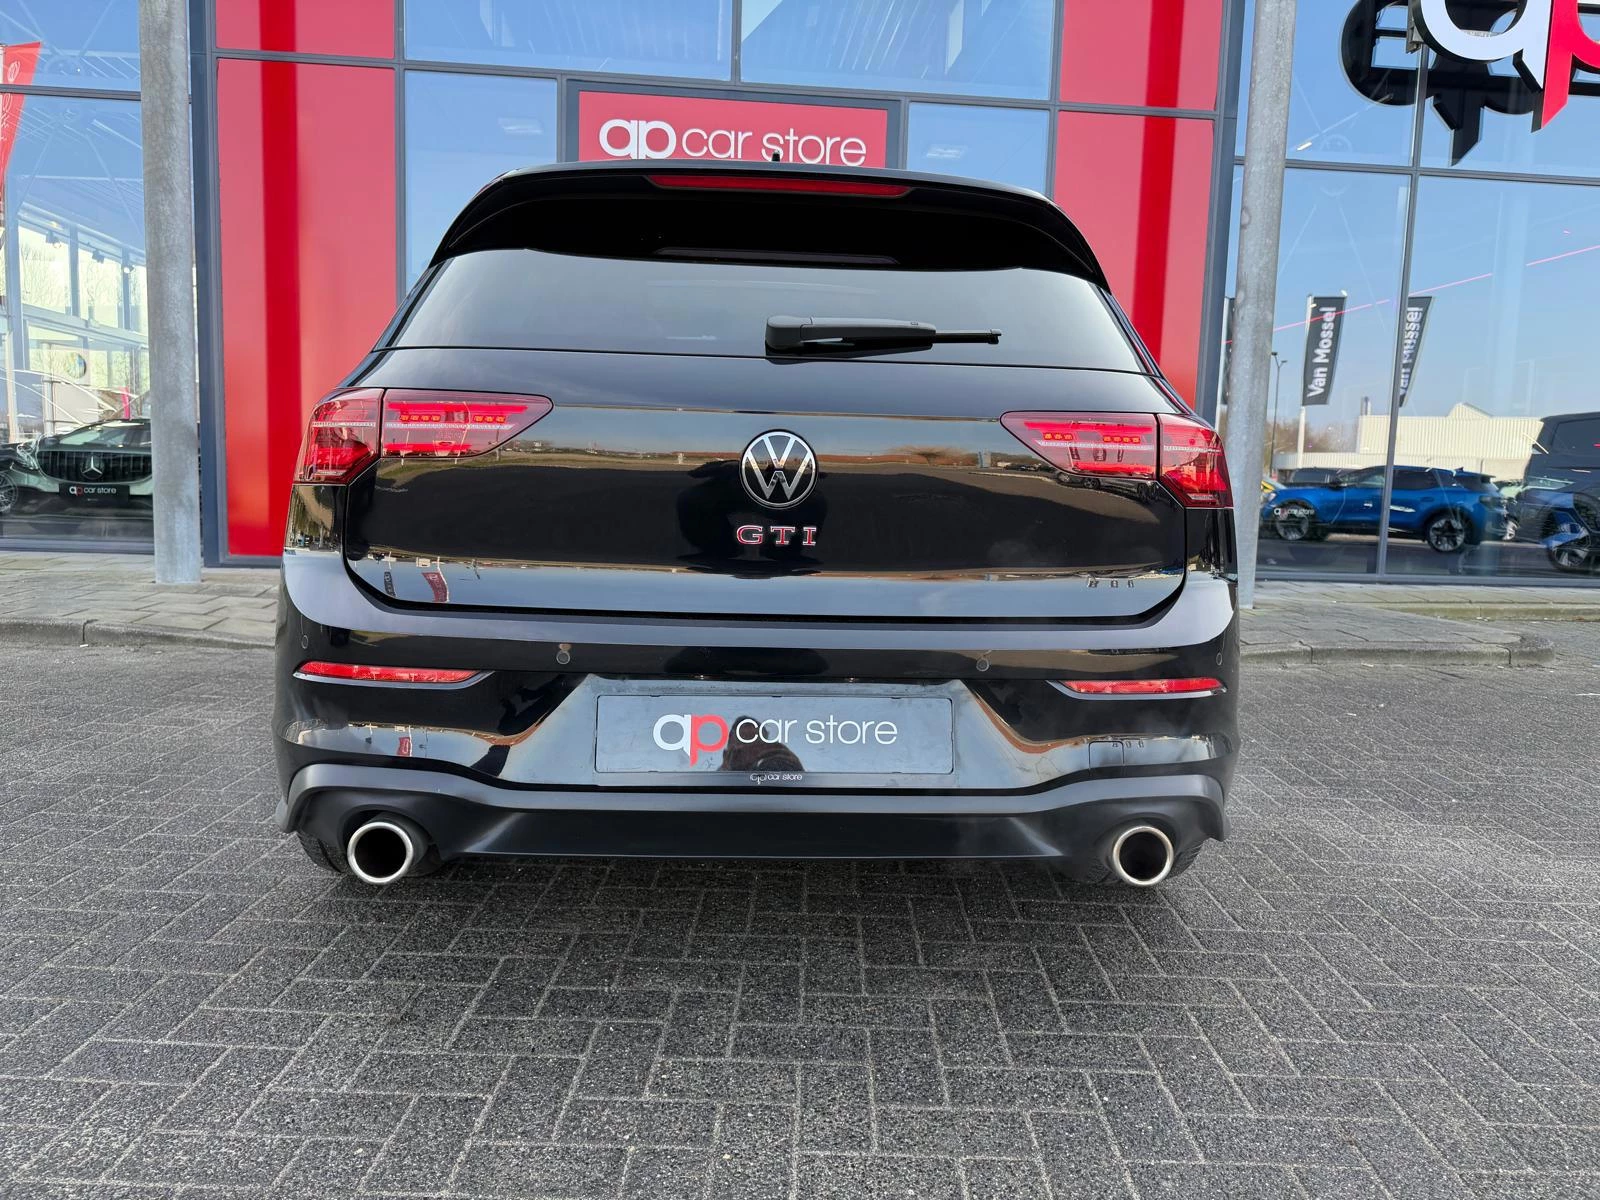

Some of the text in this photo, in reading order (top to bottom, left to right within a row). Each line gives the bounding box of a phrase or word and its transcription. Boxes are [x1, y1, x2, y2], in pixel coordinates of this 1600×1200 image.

[599, 119, 867, 167] ap car store
[1306, 306, 1336, 398] Van Mossel
[736, 525, 817, 547] GTI
[652, 714, 898, 768] ap car store
